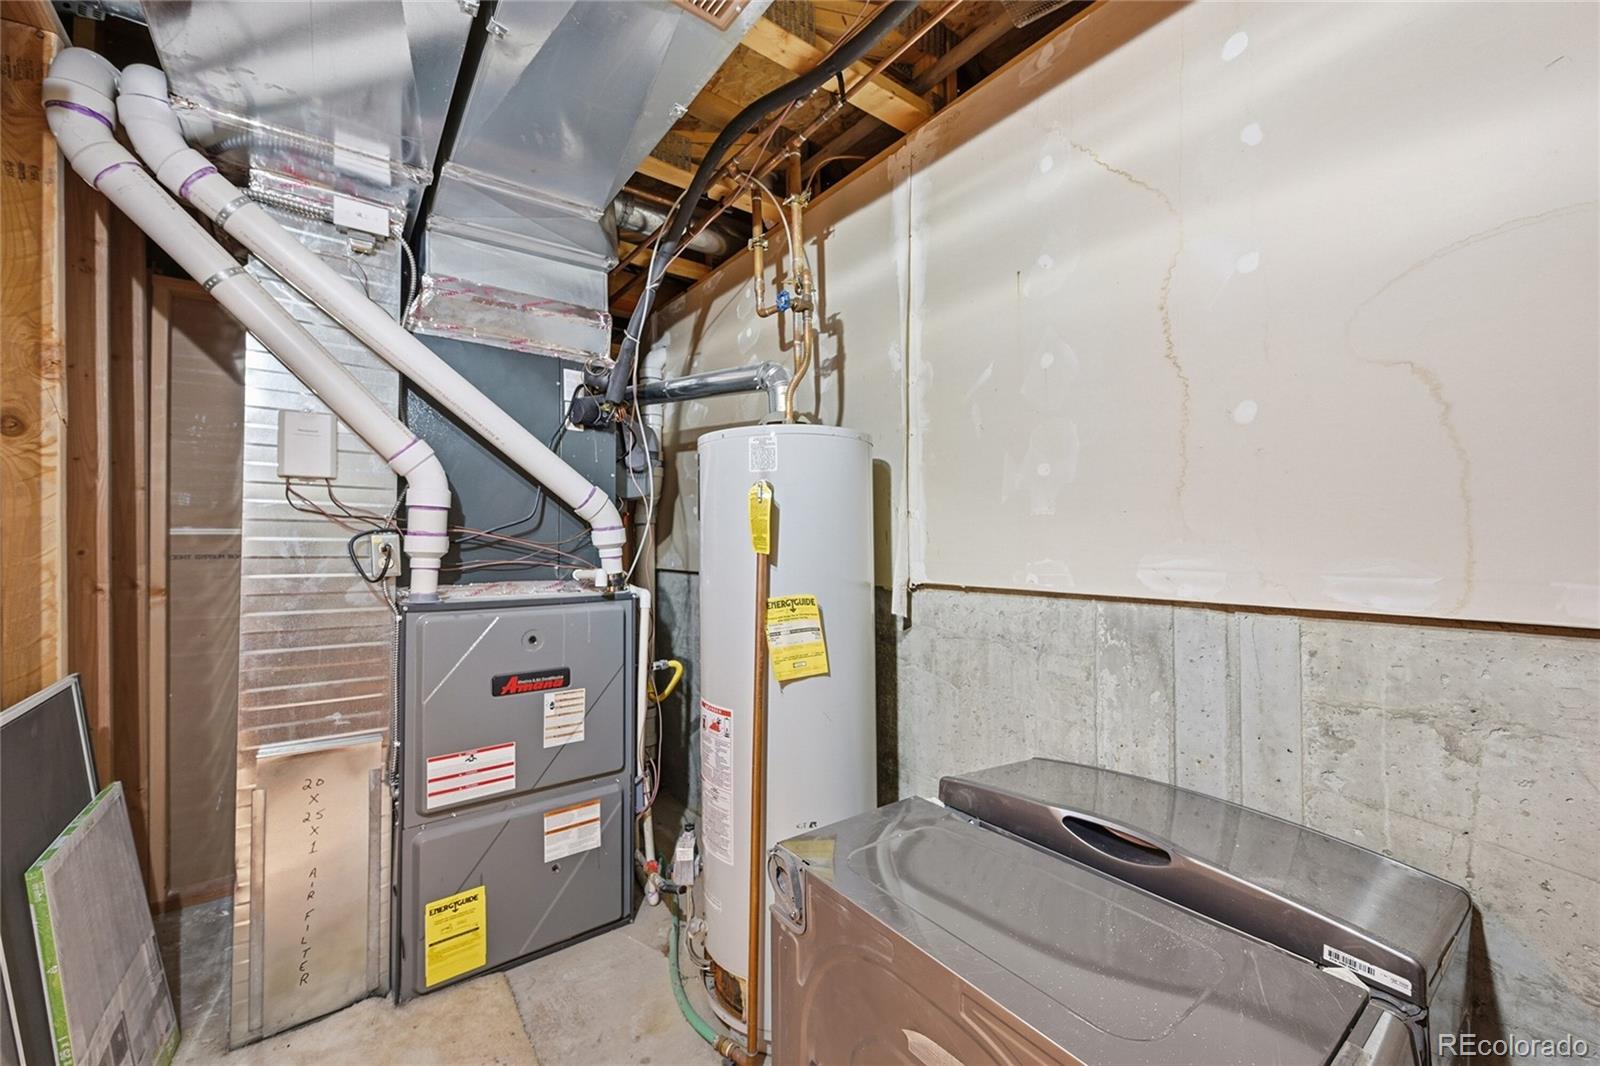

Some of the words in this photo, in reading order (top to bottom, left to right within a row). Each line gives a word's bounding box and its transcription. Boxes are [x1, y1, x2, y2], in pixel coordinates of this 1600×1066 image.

[501, 676, 564, 694] Amana
[302, 778, 325, 791] 20
[302, 808, 326, 823] 25
[308, 867, 317, 901] AIR
[299, 908, 315, 986] FILTER
